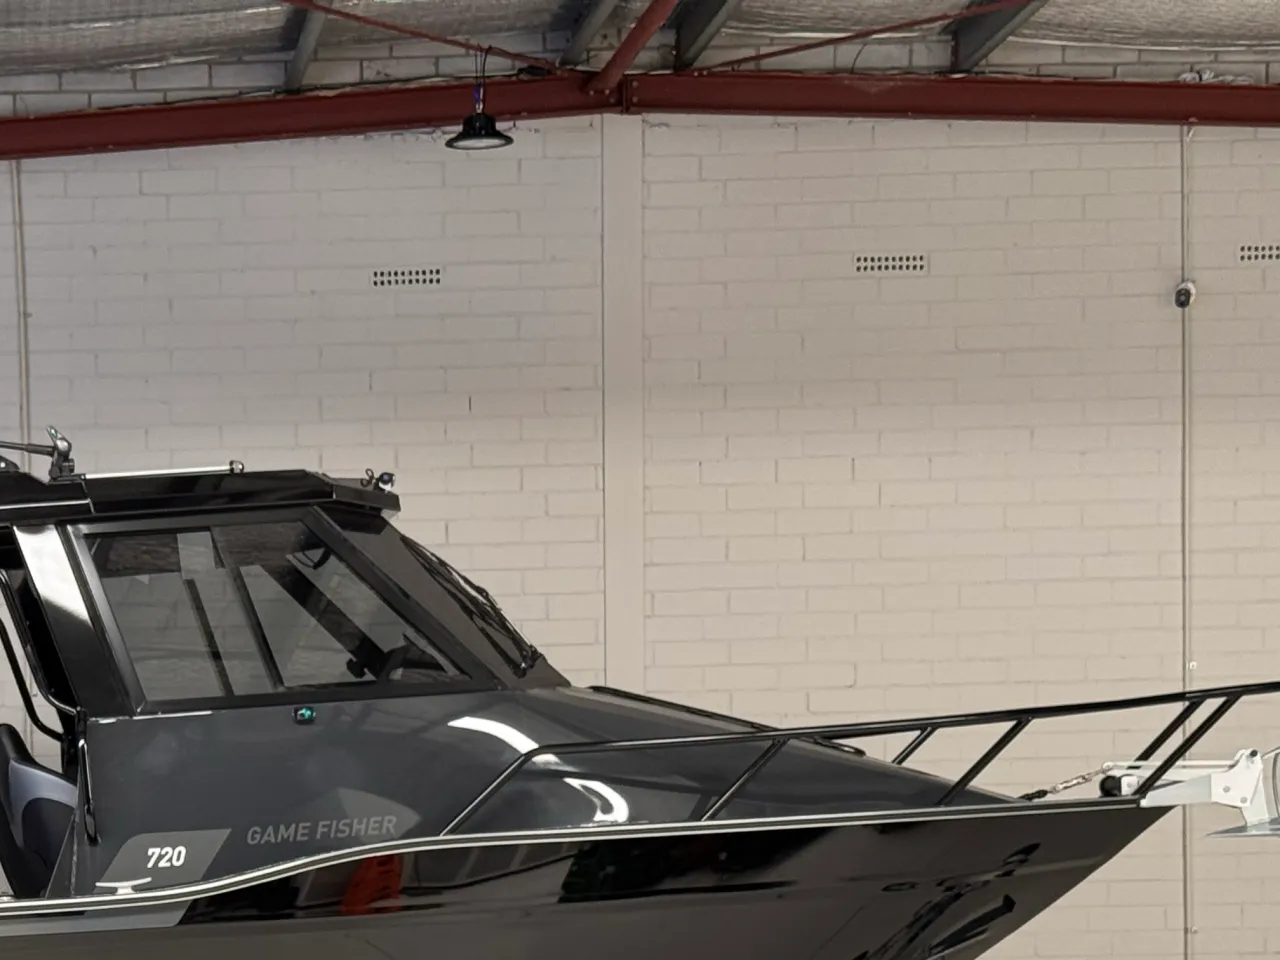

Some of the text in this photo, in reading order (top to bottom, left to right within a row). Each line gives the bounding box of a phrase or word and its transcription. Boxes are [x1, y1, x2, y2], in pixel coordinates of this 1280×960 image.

[247, 815, 397, 845] GAME FISHER
[147, 846, 186, 868] 720
